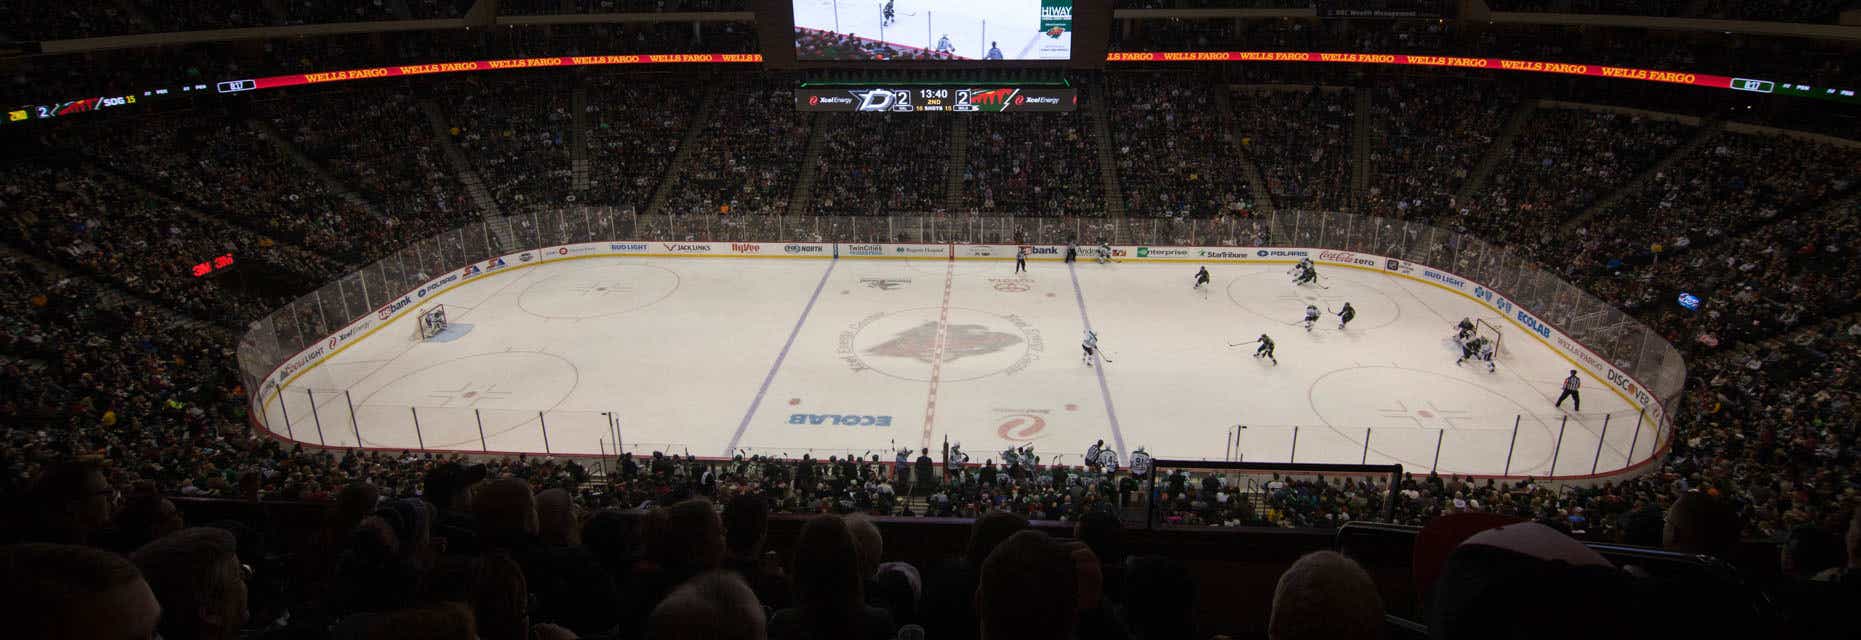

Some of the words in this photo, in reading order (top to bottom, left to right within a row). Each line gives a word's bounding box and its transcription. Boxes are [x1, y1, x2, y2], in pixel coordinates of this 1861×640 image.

[1042, 6, 1072, 16] HIWAY
[571, 56, 607, 65] WELLS
[607, 55, 640, 64] FARGO
[649, 54, 682, 63] WELLS
[682, 54, 713, 62] FARGO
[721, 54, 753, 62] WELLS
[1121, 52, 1154, 61] FARGO
[1163, 52, 1197, 61] WELLS
[1197, 52, 1230, 61] FARGO
[1239, 52, 1274, 61] WELLS
[1275, 52, 1309, 61] FARGO
[1320, 53, 1357, 62] WELLS
[1358, 54, 1395, 63] FARGO
[1407, 55, 1446, 65] WELLS
[1447, 57, 1487, 68] FARGO
[399, 64, 440, 75] WELLS
[440, 62, 478, 72] FARGO
[488, 59, 526, 69] WELLS
[527, 57, 562, 67] FARGO
[1500, 60, 1543, 71] WELLS
[1544, 63, 1587, 74] FARGO
[305, 71, 347, 83] WELLS
[348, 68, 388, 79] FARGO
[1601, 67, 1647, 79] WELLS
[1649, 71, 1695, 84] FARGO
[898, 92, 908, 105] 2
[920, 89, 948, 98] 13:40
[958, 92, 968, 105] 2
[103, 97, 125, 107] SOG
[126, 95, 136, 104] 15
[38, 107, 49, 117] 2
[1032, 246, 1058, 254] bank
[1353, 257, 1375, 267] zero
[1424, 270, 1441, 281] BUD
[1442, 274, 1465, 288] LIGHT
[1517, 309, 1551, 338] ECOLAB
[304, 347, 325, 362] LIGHT
[1607, 368, 1650, 405] DISCOVER
[787, 414, 893, 426] ECOLAB
